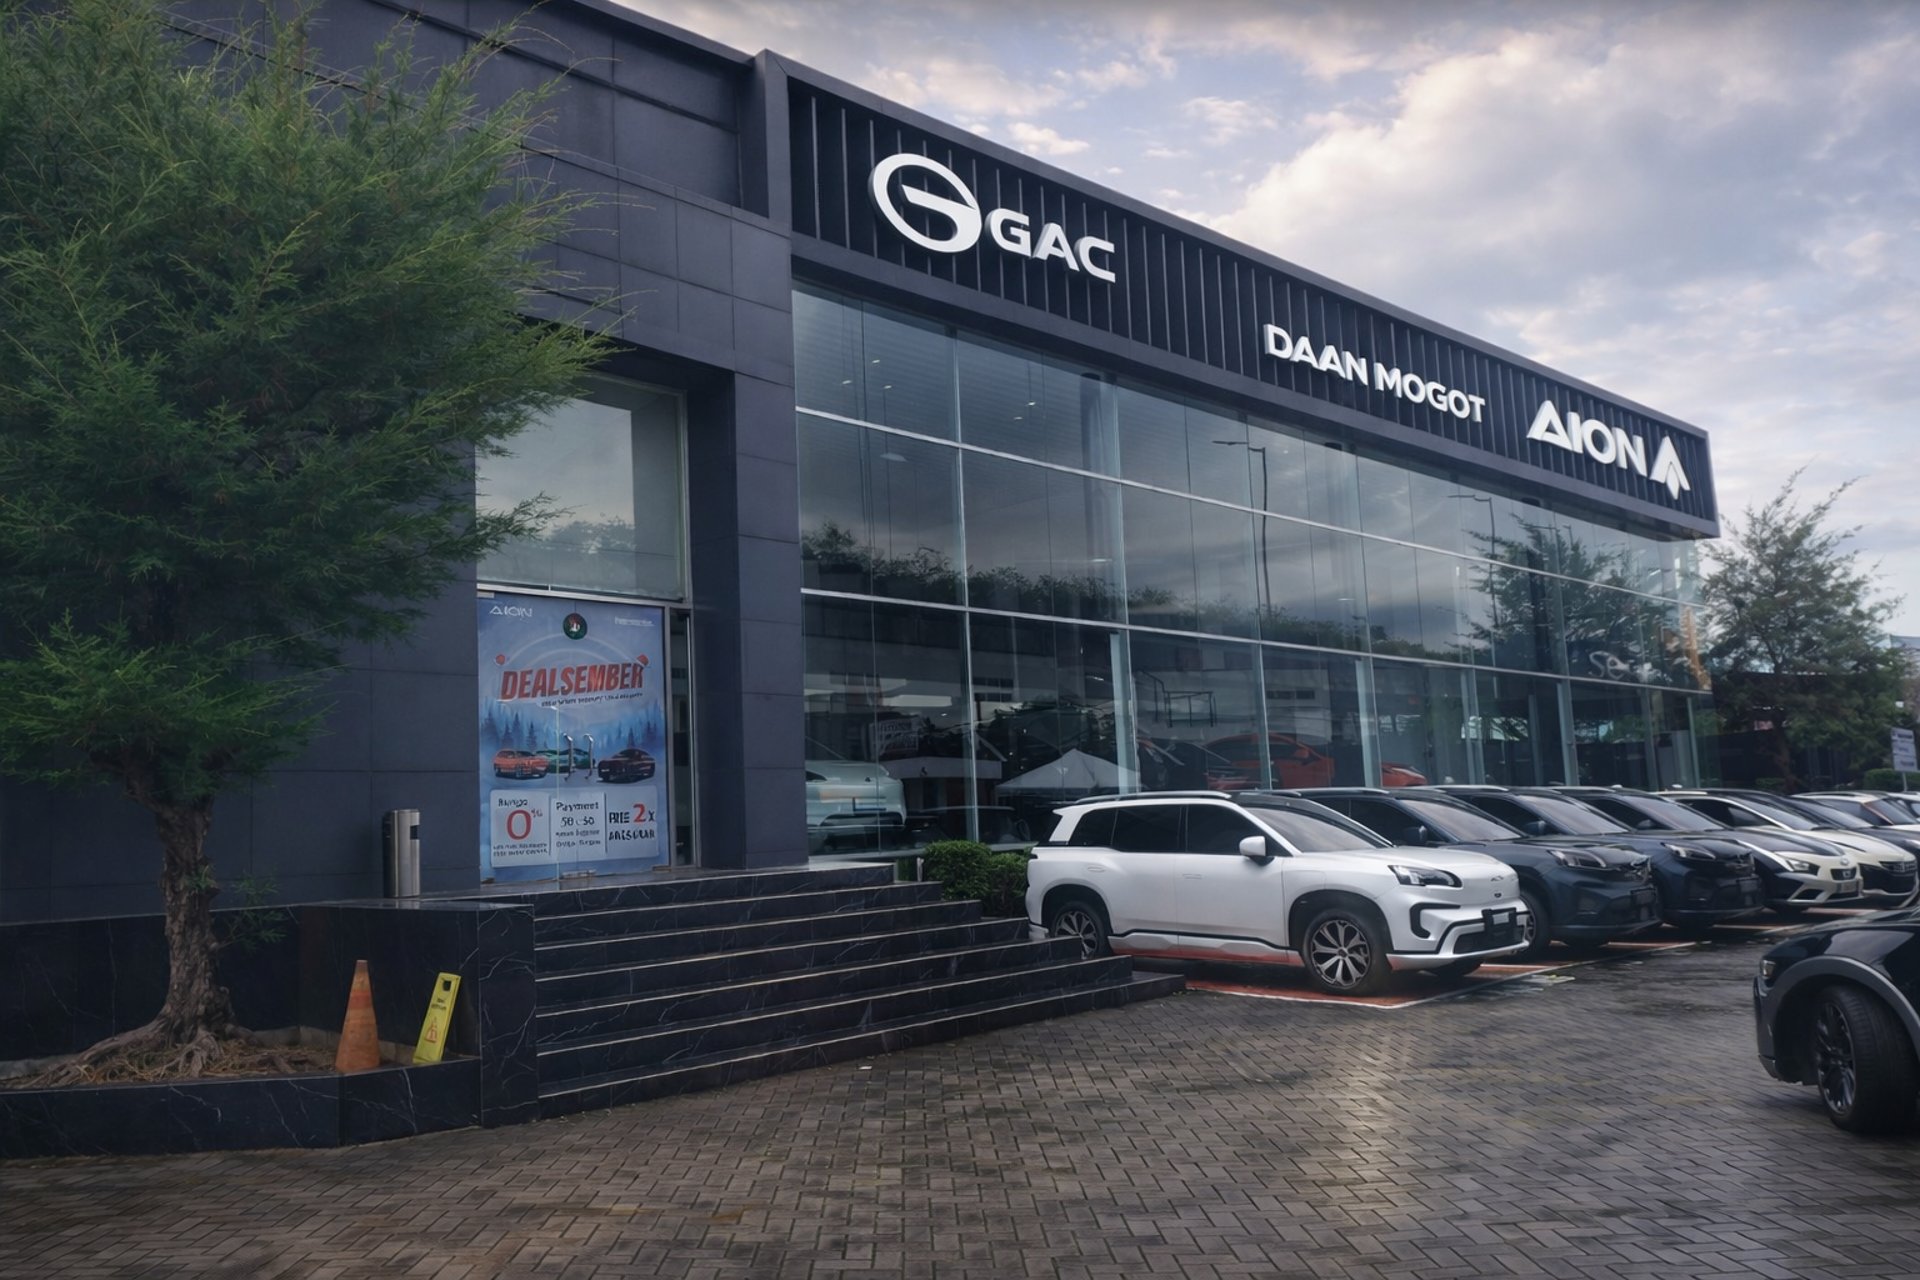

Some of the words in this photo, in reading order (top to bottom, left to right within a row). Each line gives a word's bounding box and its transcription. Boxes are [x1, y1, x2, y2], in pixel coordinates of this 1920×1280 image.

[985, 207, 1116, 283] GAC
[1264, 323, 1368, 386] DAAN
[1374, 362, 1485, 423] MOGOT
[1527, 400, 1647, 477] AION
[489, 605, 532, 618] AION
[501, 662, 645, 700] DEALSEMBER
